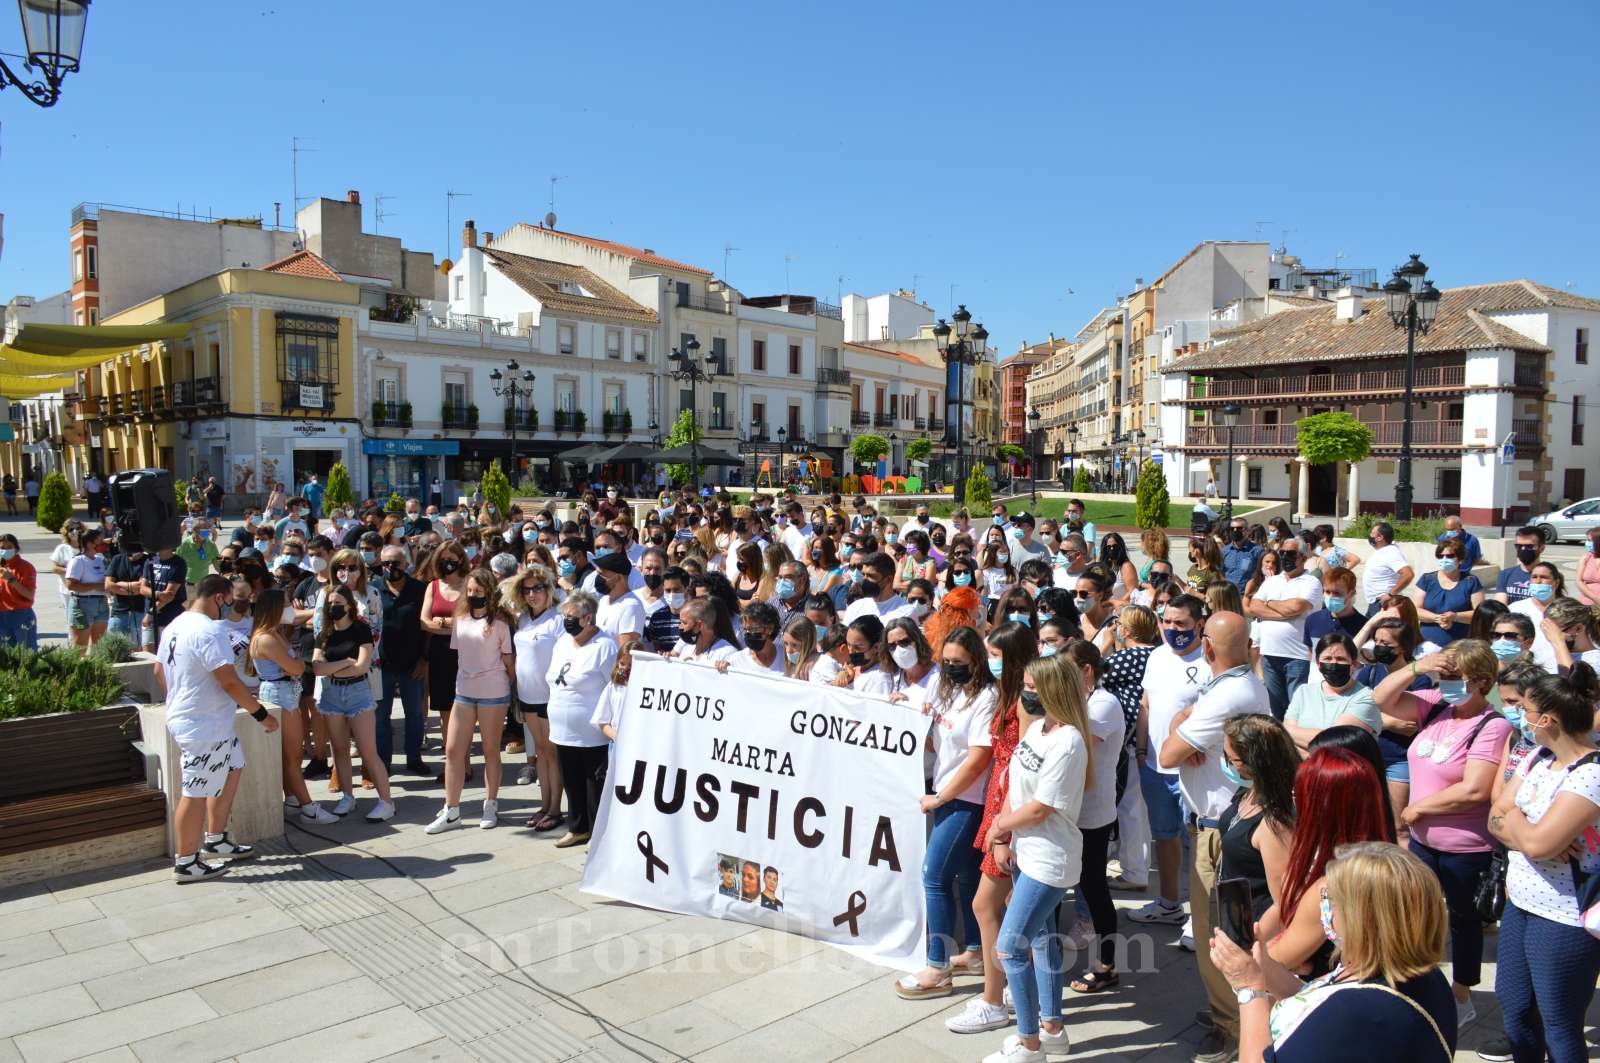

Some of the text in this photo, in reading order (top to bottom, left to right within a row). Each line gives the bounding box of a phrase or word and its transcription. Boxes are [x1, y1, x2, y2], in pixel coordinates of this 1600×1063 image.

[639, 687, 726, 722] EMOUS
[790, 709, 918, 757] GONZALO
[711, 737, 796, 777] MARTA
[614, 759, 903, 873] JUSTICIA
